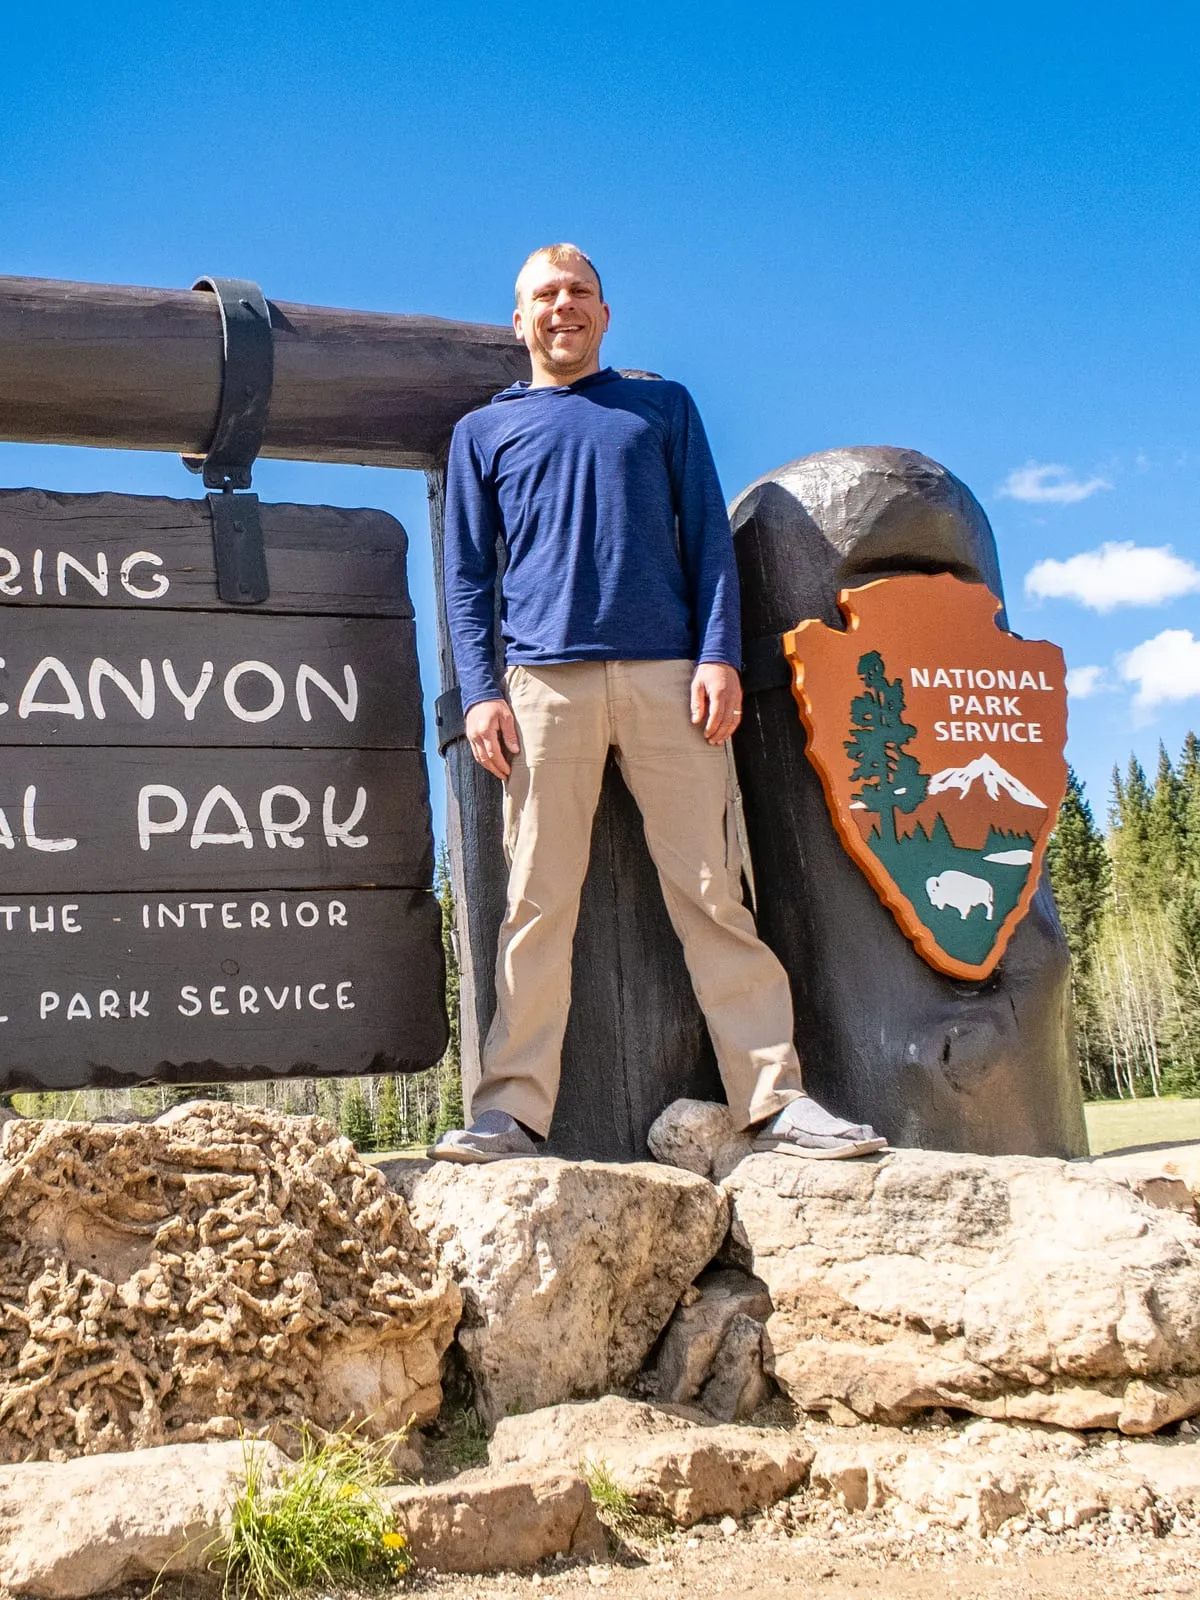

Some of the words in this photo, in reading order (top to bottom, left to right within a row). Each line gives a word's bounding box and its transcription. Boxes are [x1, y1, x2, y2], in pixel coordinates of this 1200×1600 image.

[910, 667, 1054, 691] NATIONAL
[949, 694, 1022, 716] PARK
[933, 721, 1043, 743] SERVICE
[137, 784, 369, 851] PARK
[142, 900, 348, 929] INTERIOR
[39, 989, 150, 1021] PARK
[177, 981, 356, 1017] SERVICE
